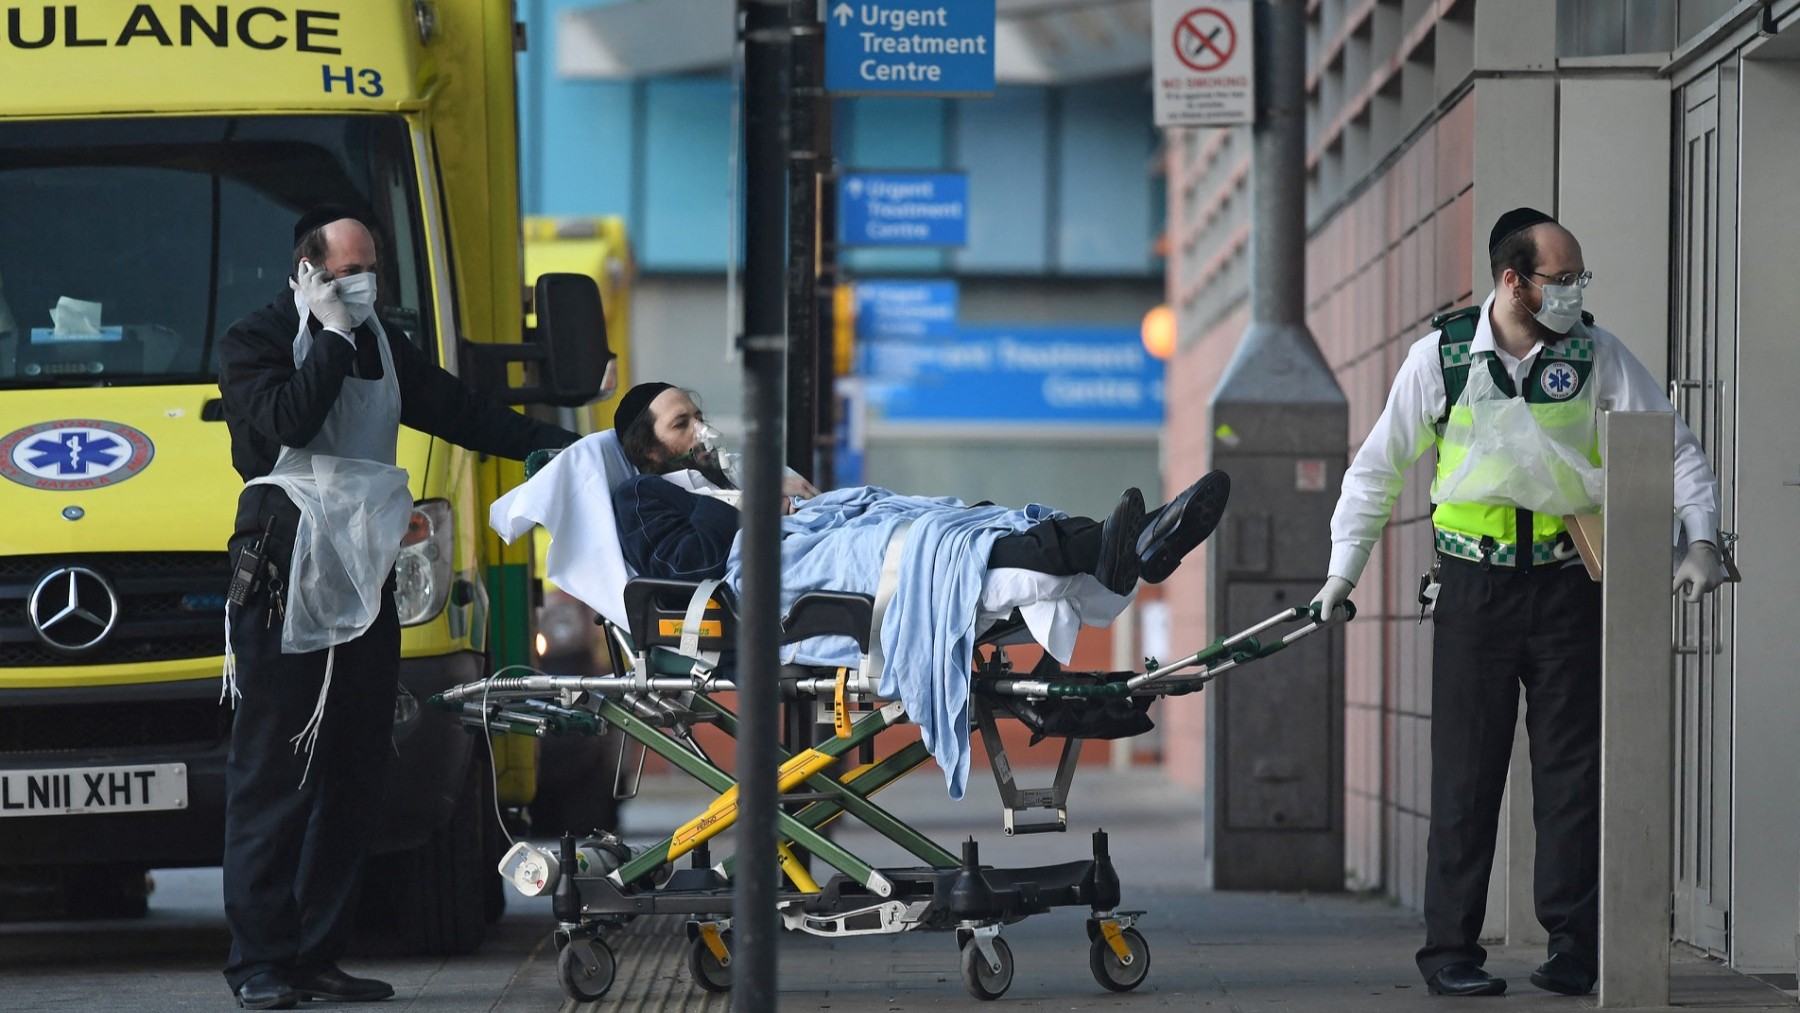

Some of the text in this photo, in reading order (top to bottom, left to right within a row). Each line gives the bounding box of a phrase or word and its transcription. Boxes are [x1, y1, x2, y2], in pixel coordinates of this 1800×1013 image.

[861, 4, 947, 32] Urgent
[859, 32, 986, 54] Treatment
[322, 64, 384, 98] H3
[860, 59, 941, 81] Centre
[866, 179, 934, 201] Urgent
[867, 202, 962, 218] Treatment
[866, 220, 930, 239] Centre
[83, 770, 155, 806] XHT
